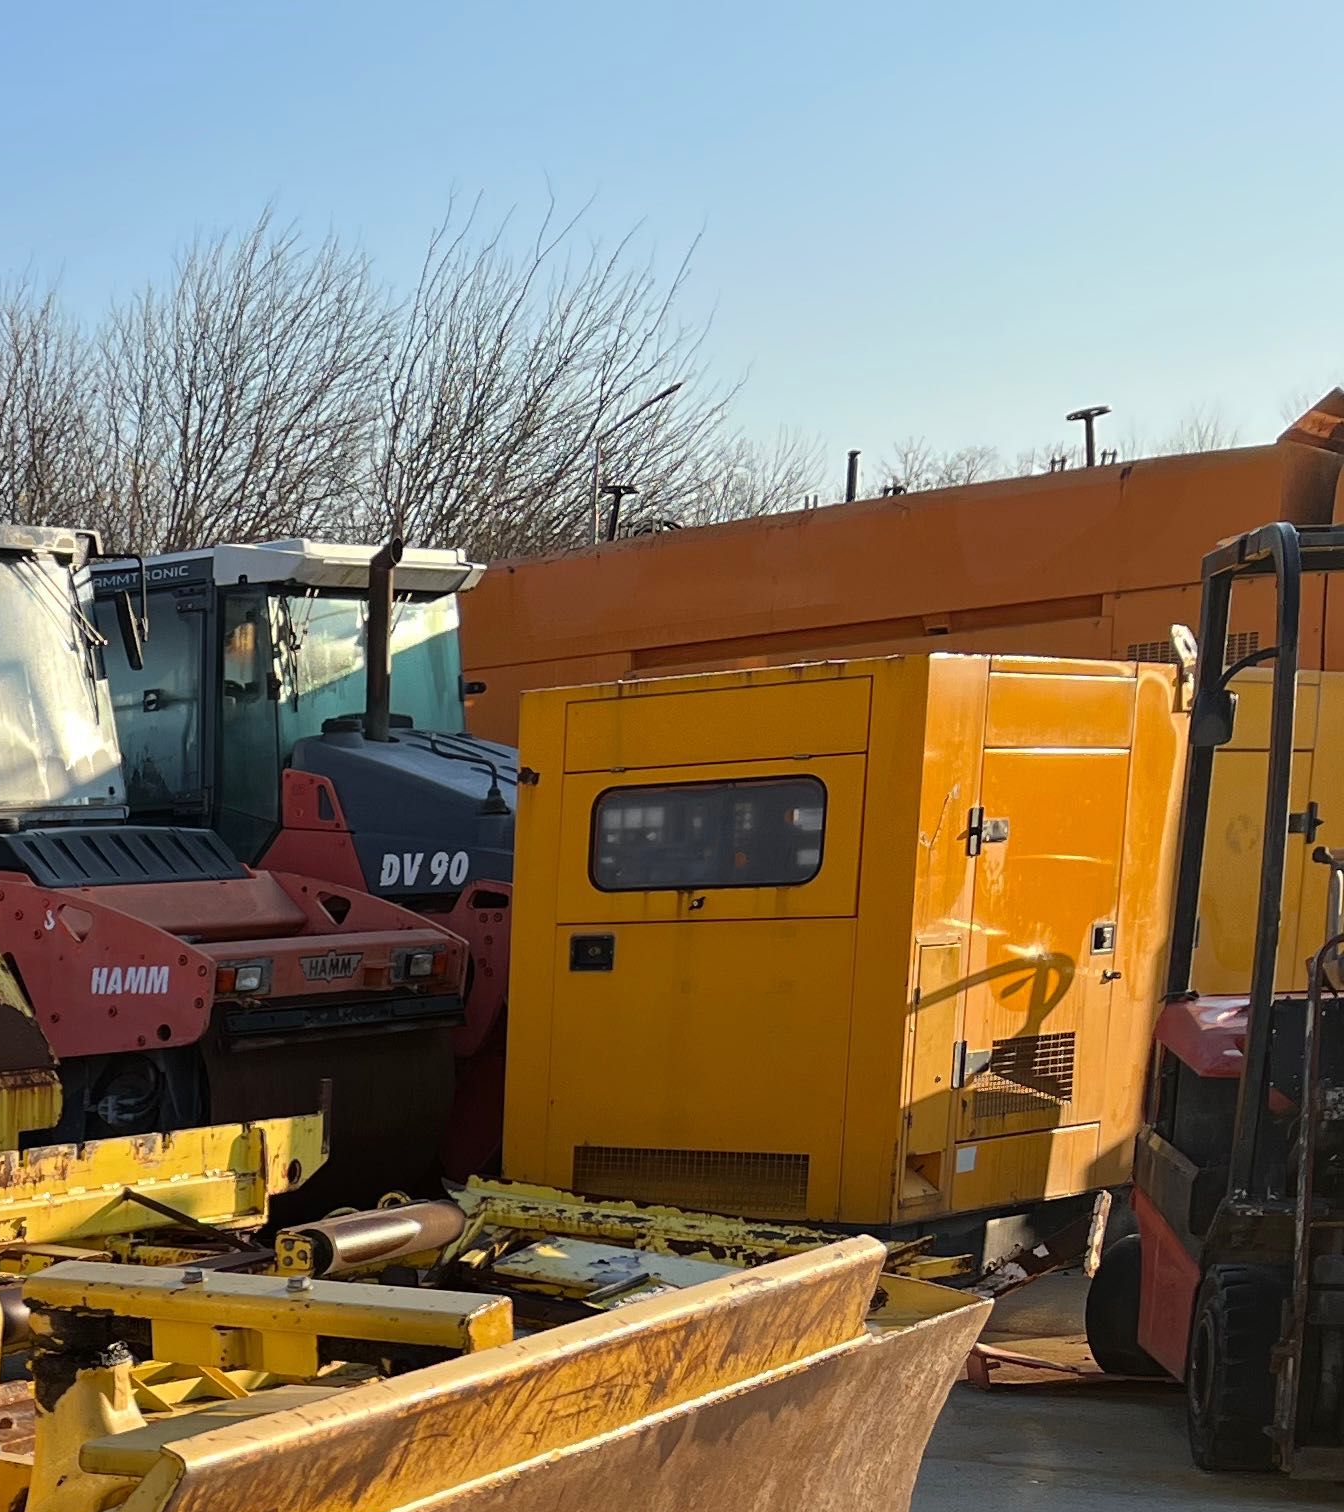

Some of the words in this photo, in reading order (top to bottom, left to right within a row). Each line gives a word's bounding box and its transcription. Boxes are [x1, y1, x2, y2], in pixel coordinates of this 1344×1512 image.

[93, 565, 190, 588] AMMTRONIC
[379, 853, 424, 886] DV
[430, 850, 470, 886] 90
[91, 966, 169, 995] HAMM
[308, 957, 353, 978] HAMM
